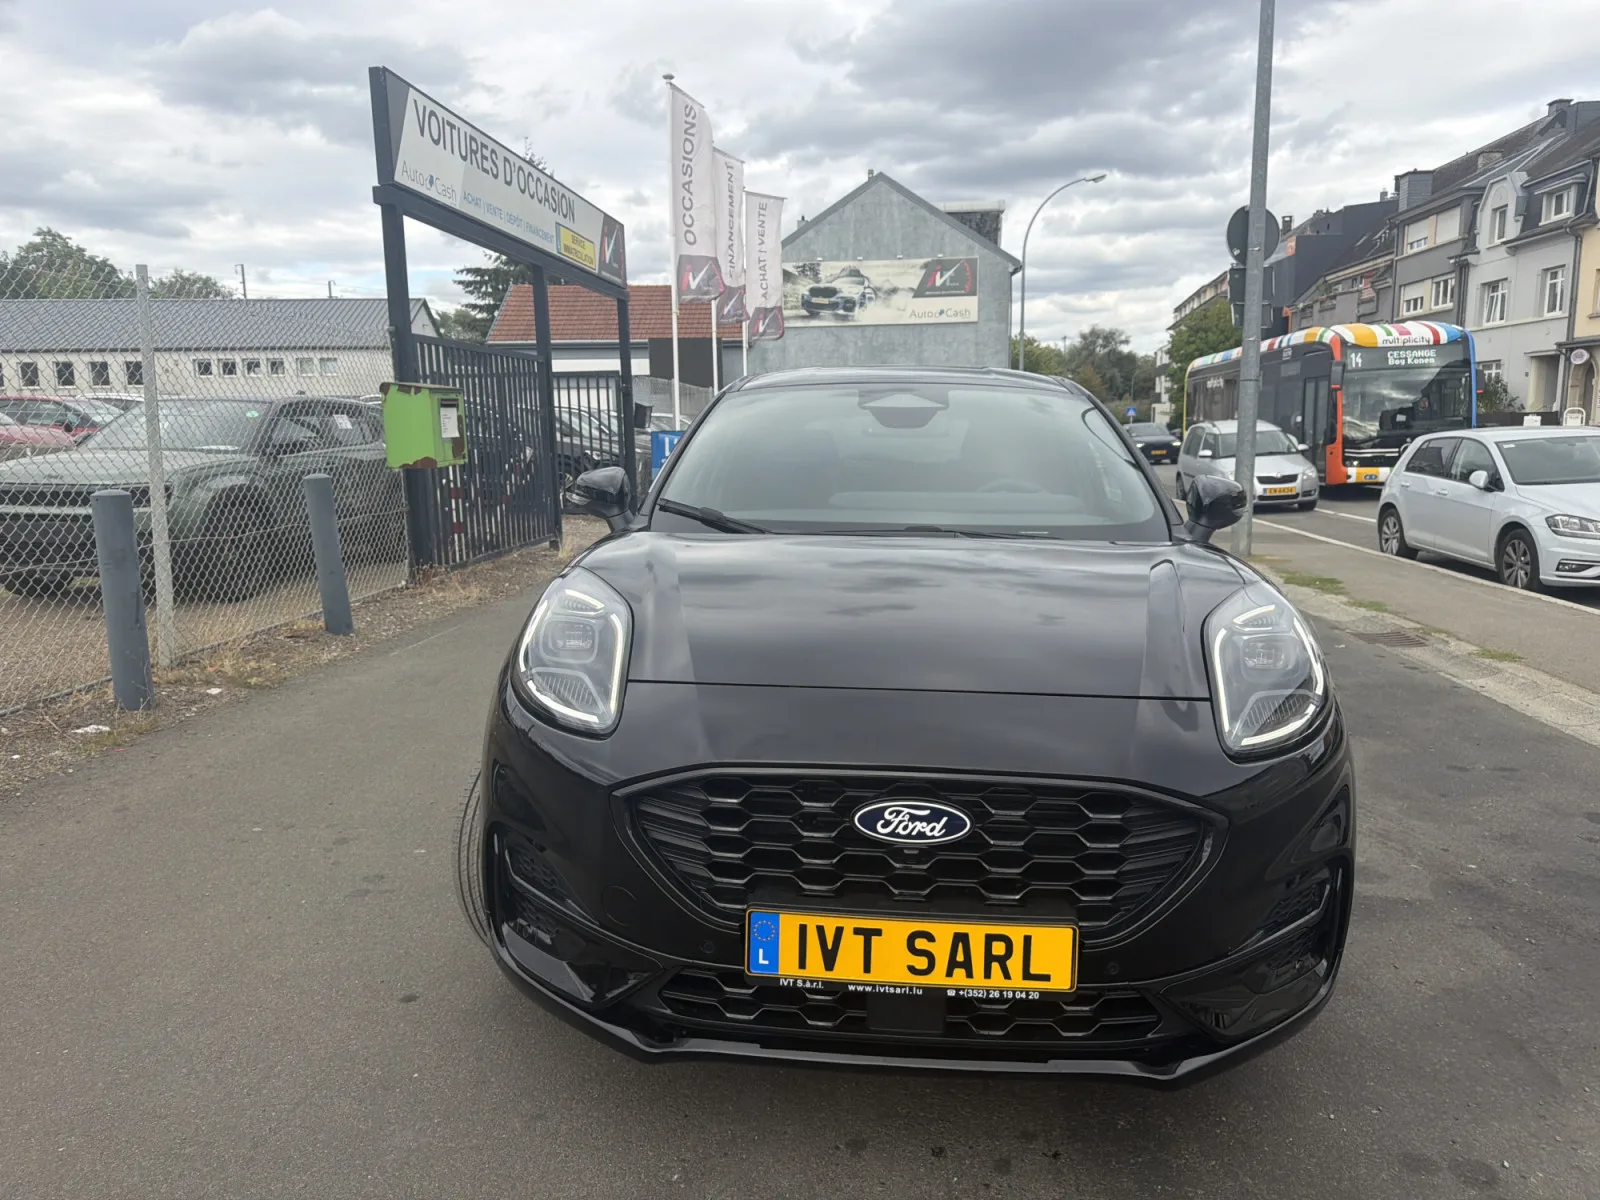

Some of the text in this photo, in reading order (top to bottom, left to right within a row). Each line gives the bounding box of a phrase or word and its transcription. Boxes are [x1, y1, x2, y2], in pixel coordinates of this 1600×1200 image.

[413, 98, 575, 224] VOITURES D'OCCASION
[401, 159, 457, 203] Auto Cash
[681, 103, 698, 247] OCCASIONS
[757, 201, 769, 301] ACHAT VENTE
[909, 307, 971, 320] Auto Cash
[1350, 352, 1363, 368] 14
[1387, 349, 1437, 359] CESSANGE
[1388, 357, 1435, 366] Boy Konen
[876, 806, 949, 837] Ford
[758, 948, 770, 965] L
[798, 923, 1052, 983] IVT SARL
[779, 978, 825, 989] IVT S.à.r.l.
[848, 983, 923, 995] www.ivtsarl.lu
[958, 989, 1040, 1000] +(352) 26 19 04 20
